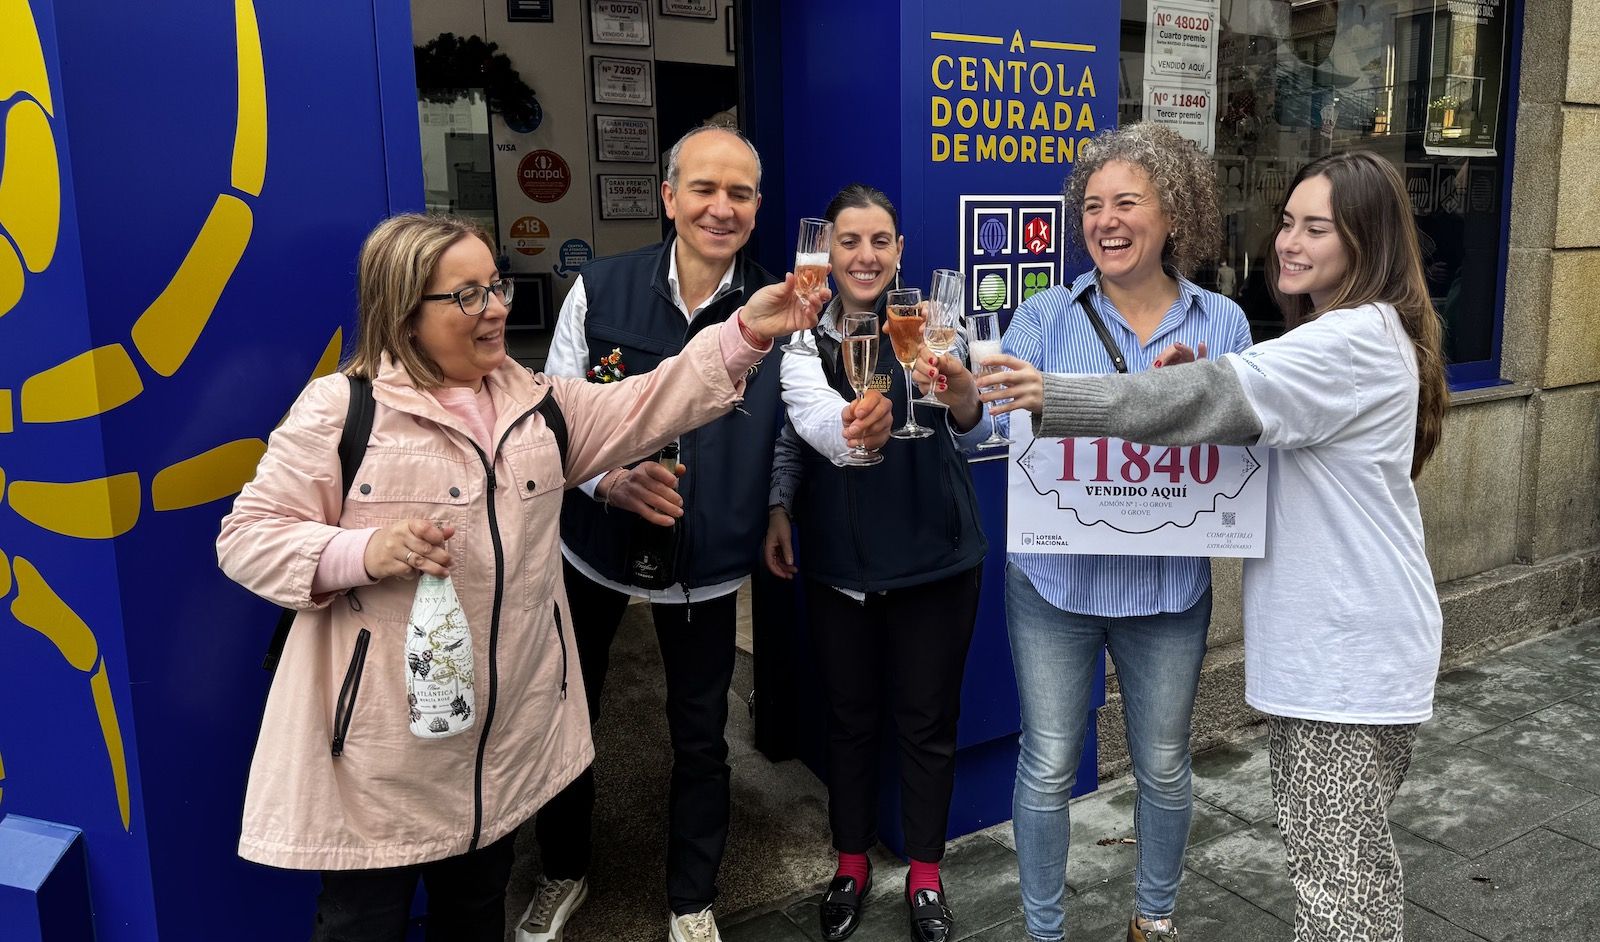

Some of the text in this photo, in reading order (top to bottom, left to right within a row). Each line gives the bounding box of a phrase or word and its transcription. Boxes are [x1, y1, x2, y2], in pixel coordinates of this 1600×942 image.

[610, 5, 639, 14] 00750
[1158, 13, 1209, 31] Nº 48020
[1010, 29, 1025, 53] A
[1160, 30, 1206, 43] Cuarto premio
[614, 66, 642, 76] 72897
[1158, 61, 1205, 72] VENDIDO AQUÍ
[931, 55, 1097, 97] CENTOLA
[1154, 92, 1206, 108] Nº 11840
[932, 96, 1095, 131] DOURADA
[1157, 109, 1202, 120] Tercer premio
[932, 133, 969, 162] DE
[524, 167, 564, 181] anapal
[517, 220, 540, 233] +18
[1056, 437, 1220, 484] 11840
[1085, 484, 1187, 500] VENDIDO AQUÍ
